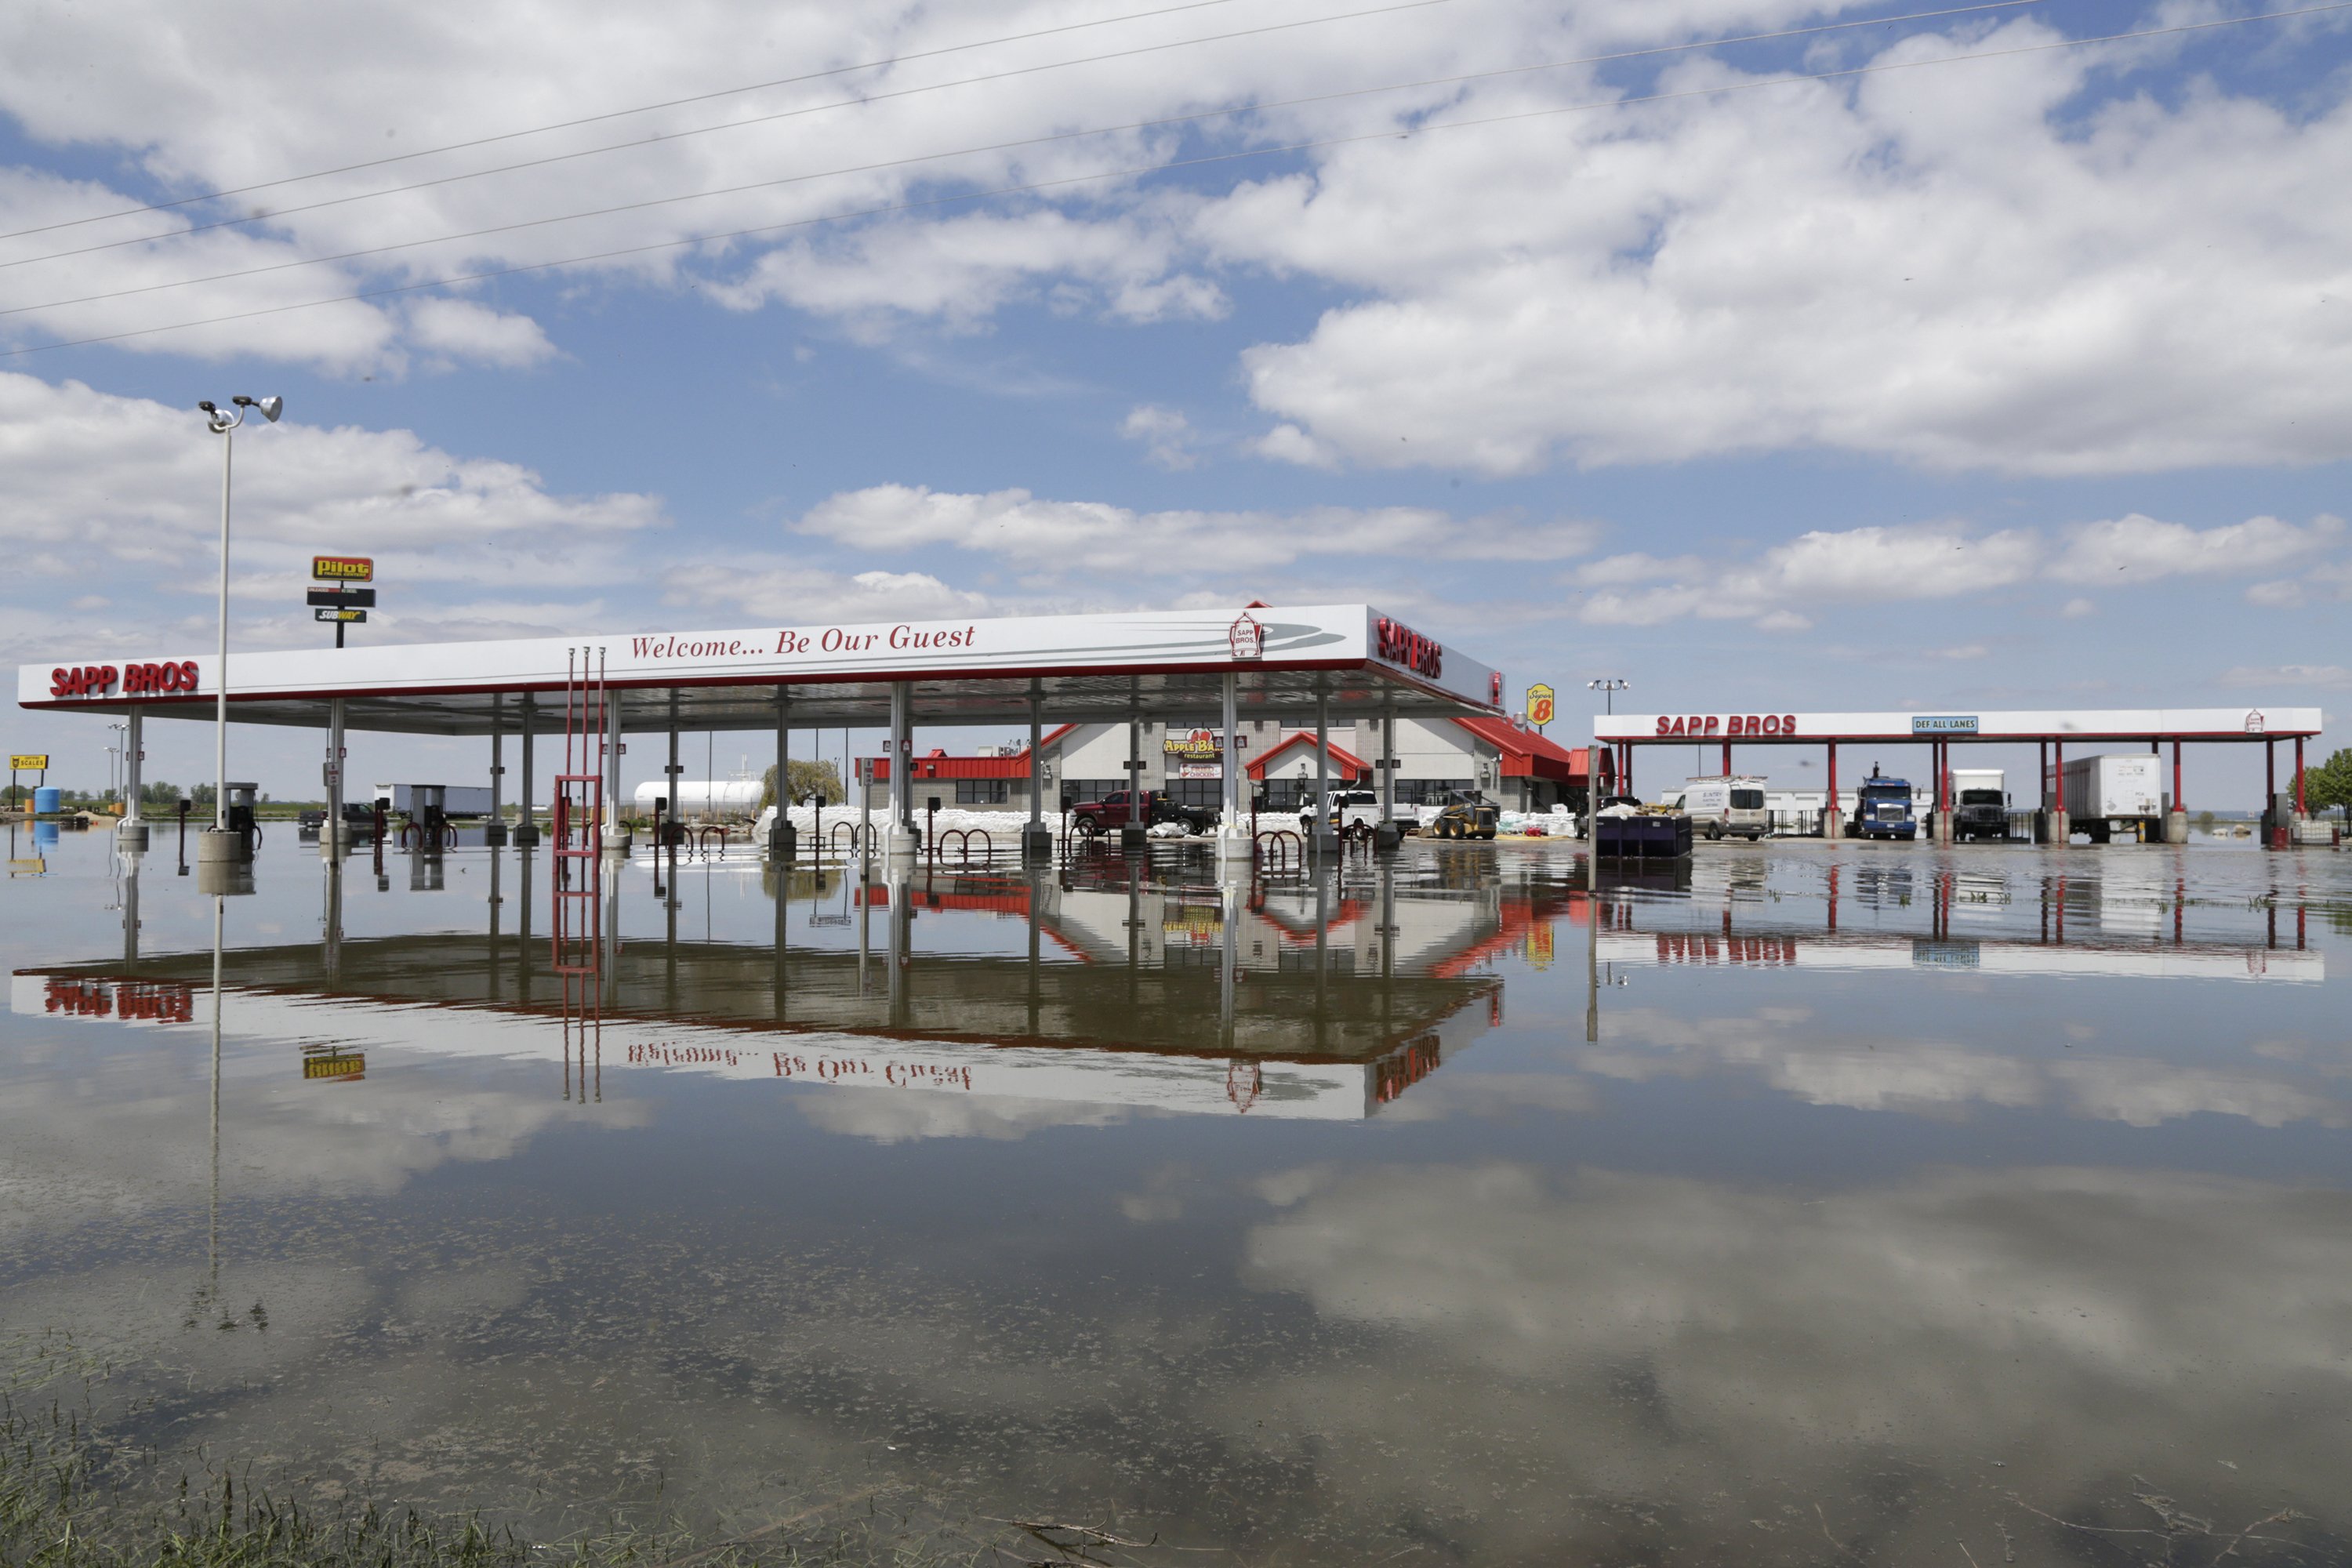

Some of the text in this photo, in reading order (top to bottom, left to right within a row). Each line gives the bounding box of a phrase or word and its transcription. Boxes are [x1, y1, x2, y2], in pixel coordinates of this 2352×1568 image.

[317, 561, 369, 575] Pilot
[318, 610, 361, 619] SUBWAY
[632, 625, 975, 659] Welcome... Be Our Guest
[50, 661, 199, 697] SAPP BROS
[1529, 690, 1552, 702] Super
[1534, 699, 1552, 720] 8
[1656, 714, 1796, 735] SAPP BROS
